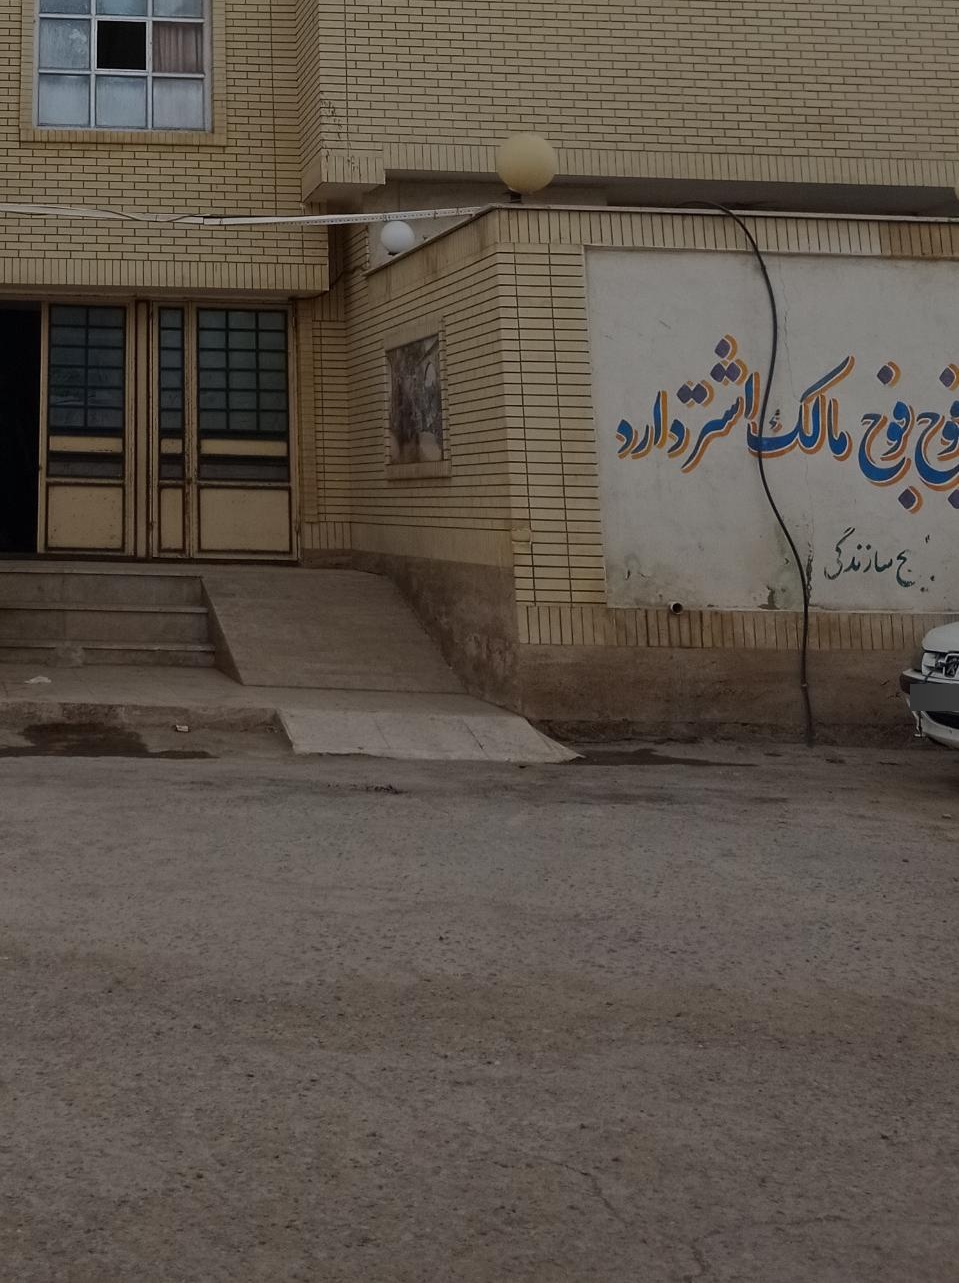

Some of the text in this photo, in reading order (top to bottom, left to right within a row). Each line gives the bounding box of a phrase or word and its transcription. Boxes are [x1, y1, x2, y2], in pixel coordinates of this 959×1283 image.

[616, 390, 691, 460] دارد
[676, 334, 760, 474] اشتر
[747, 355, 856, 462] مالک
[858, 361, 924, 515] فوج
[823, 526, 894, 581] سازندگی
